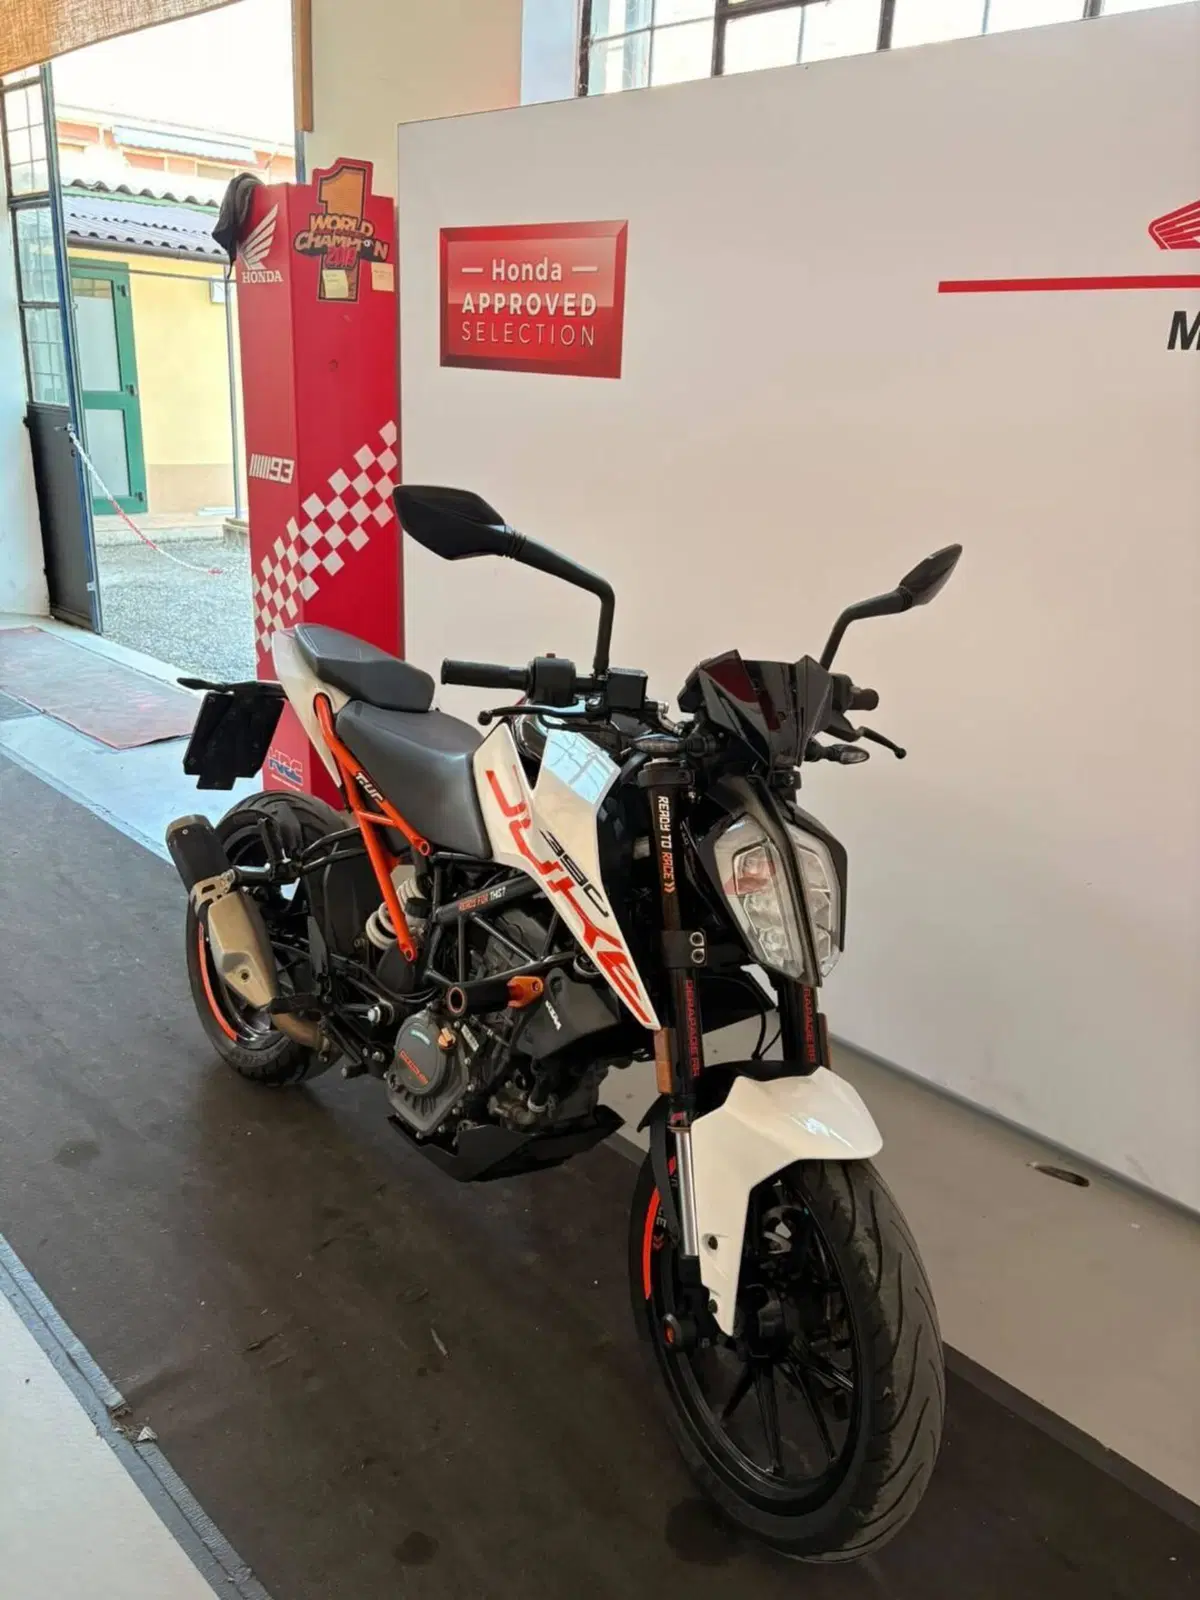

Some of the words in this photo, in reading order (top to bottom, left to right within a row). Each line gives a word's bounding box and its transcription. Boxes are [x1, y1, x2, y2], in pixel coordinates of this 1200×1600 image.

[310, 214, 374, 236] WORLD
[241, 269, 284, 284] HONDA
[492, 257, 562, 281] Honda
[462, 292, 596, 316] APPROVED
[462, 321, 594, 346] SELECTION
[657, 795, 671, 832] READY
[660, 834, 673, 849] TO
[662, 851, 675, 880] RACE
